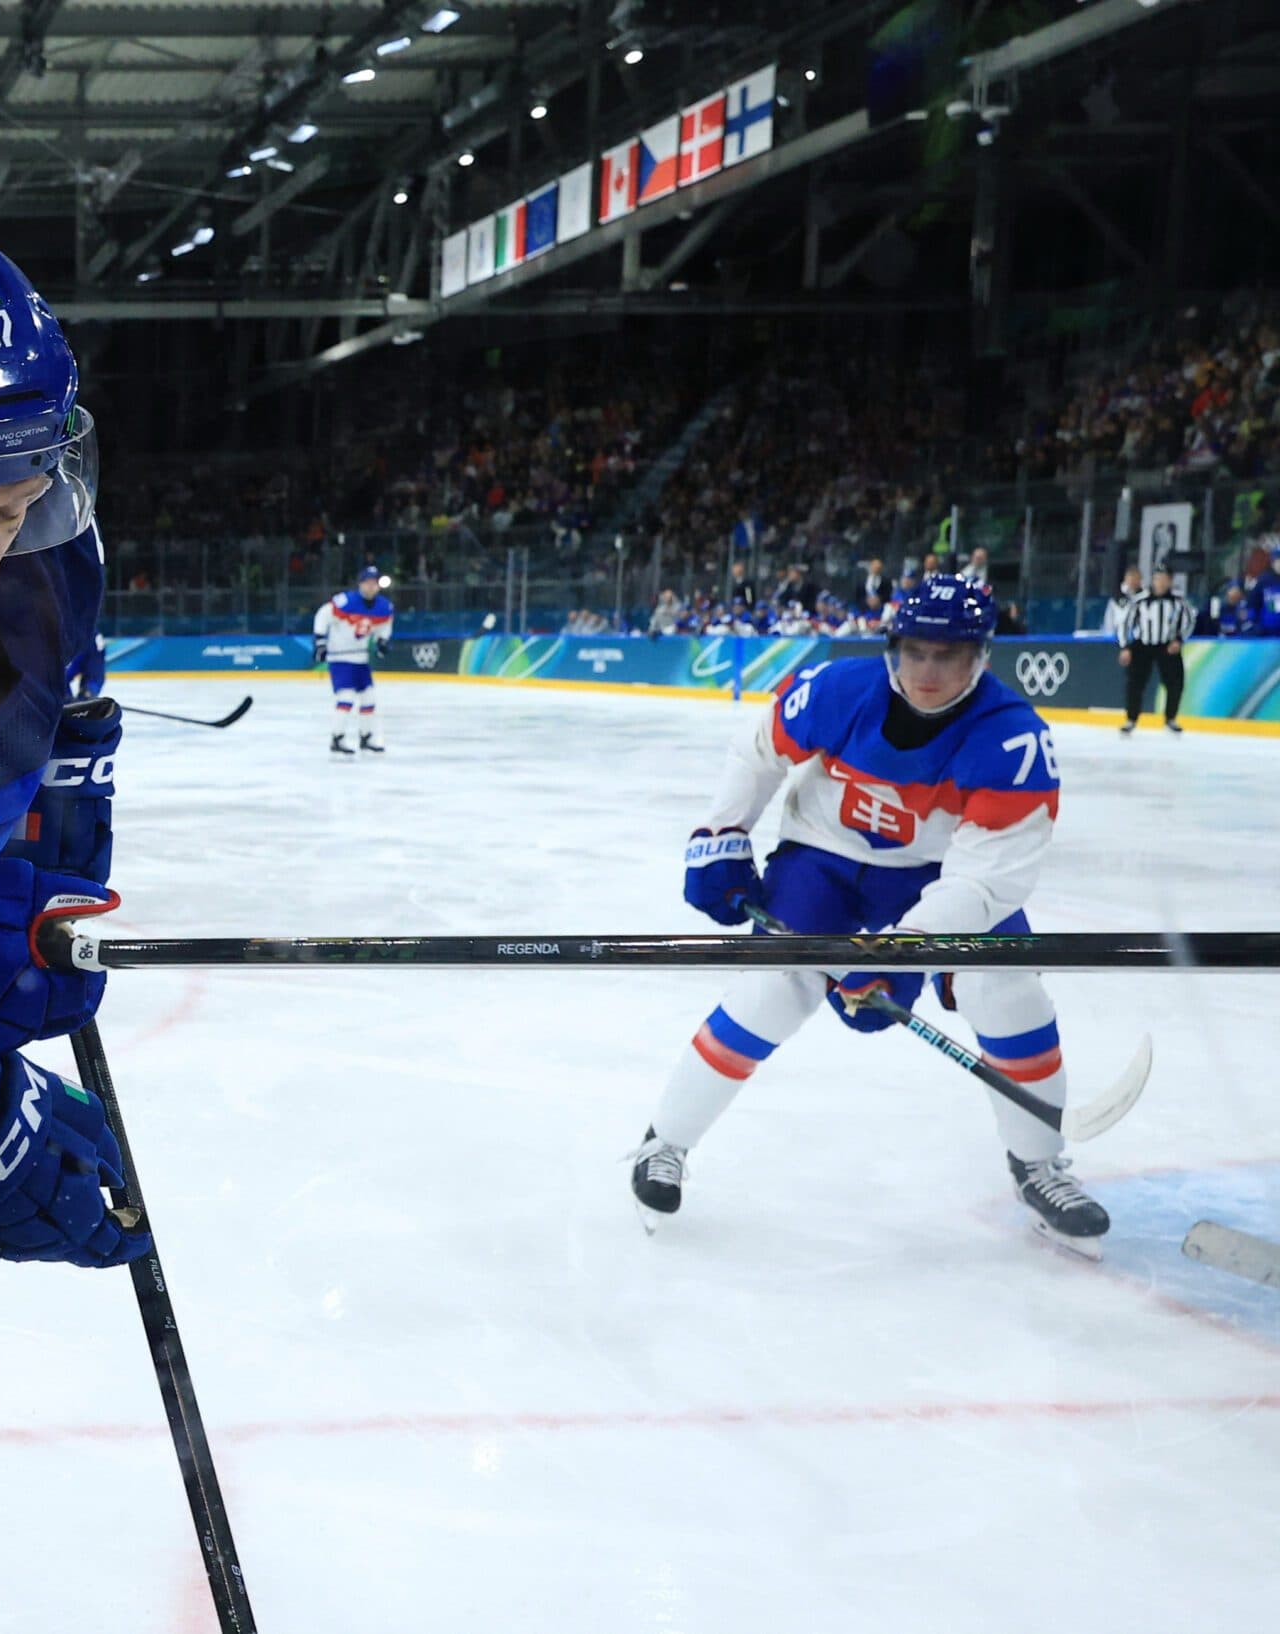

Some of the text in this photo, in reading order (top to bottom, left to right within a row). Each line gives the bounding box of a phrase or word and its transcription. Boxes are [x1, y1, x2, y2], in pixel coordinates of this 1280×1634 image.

[15, 426, 49, 438] CORTINA
[930, 585, 956, 600] 76
[1001, 729, 1061, 786] 76
[42, 757, 113, 787] CC
[497, 943, 560, 955] REGENDA
